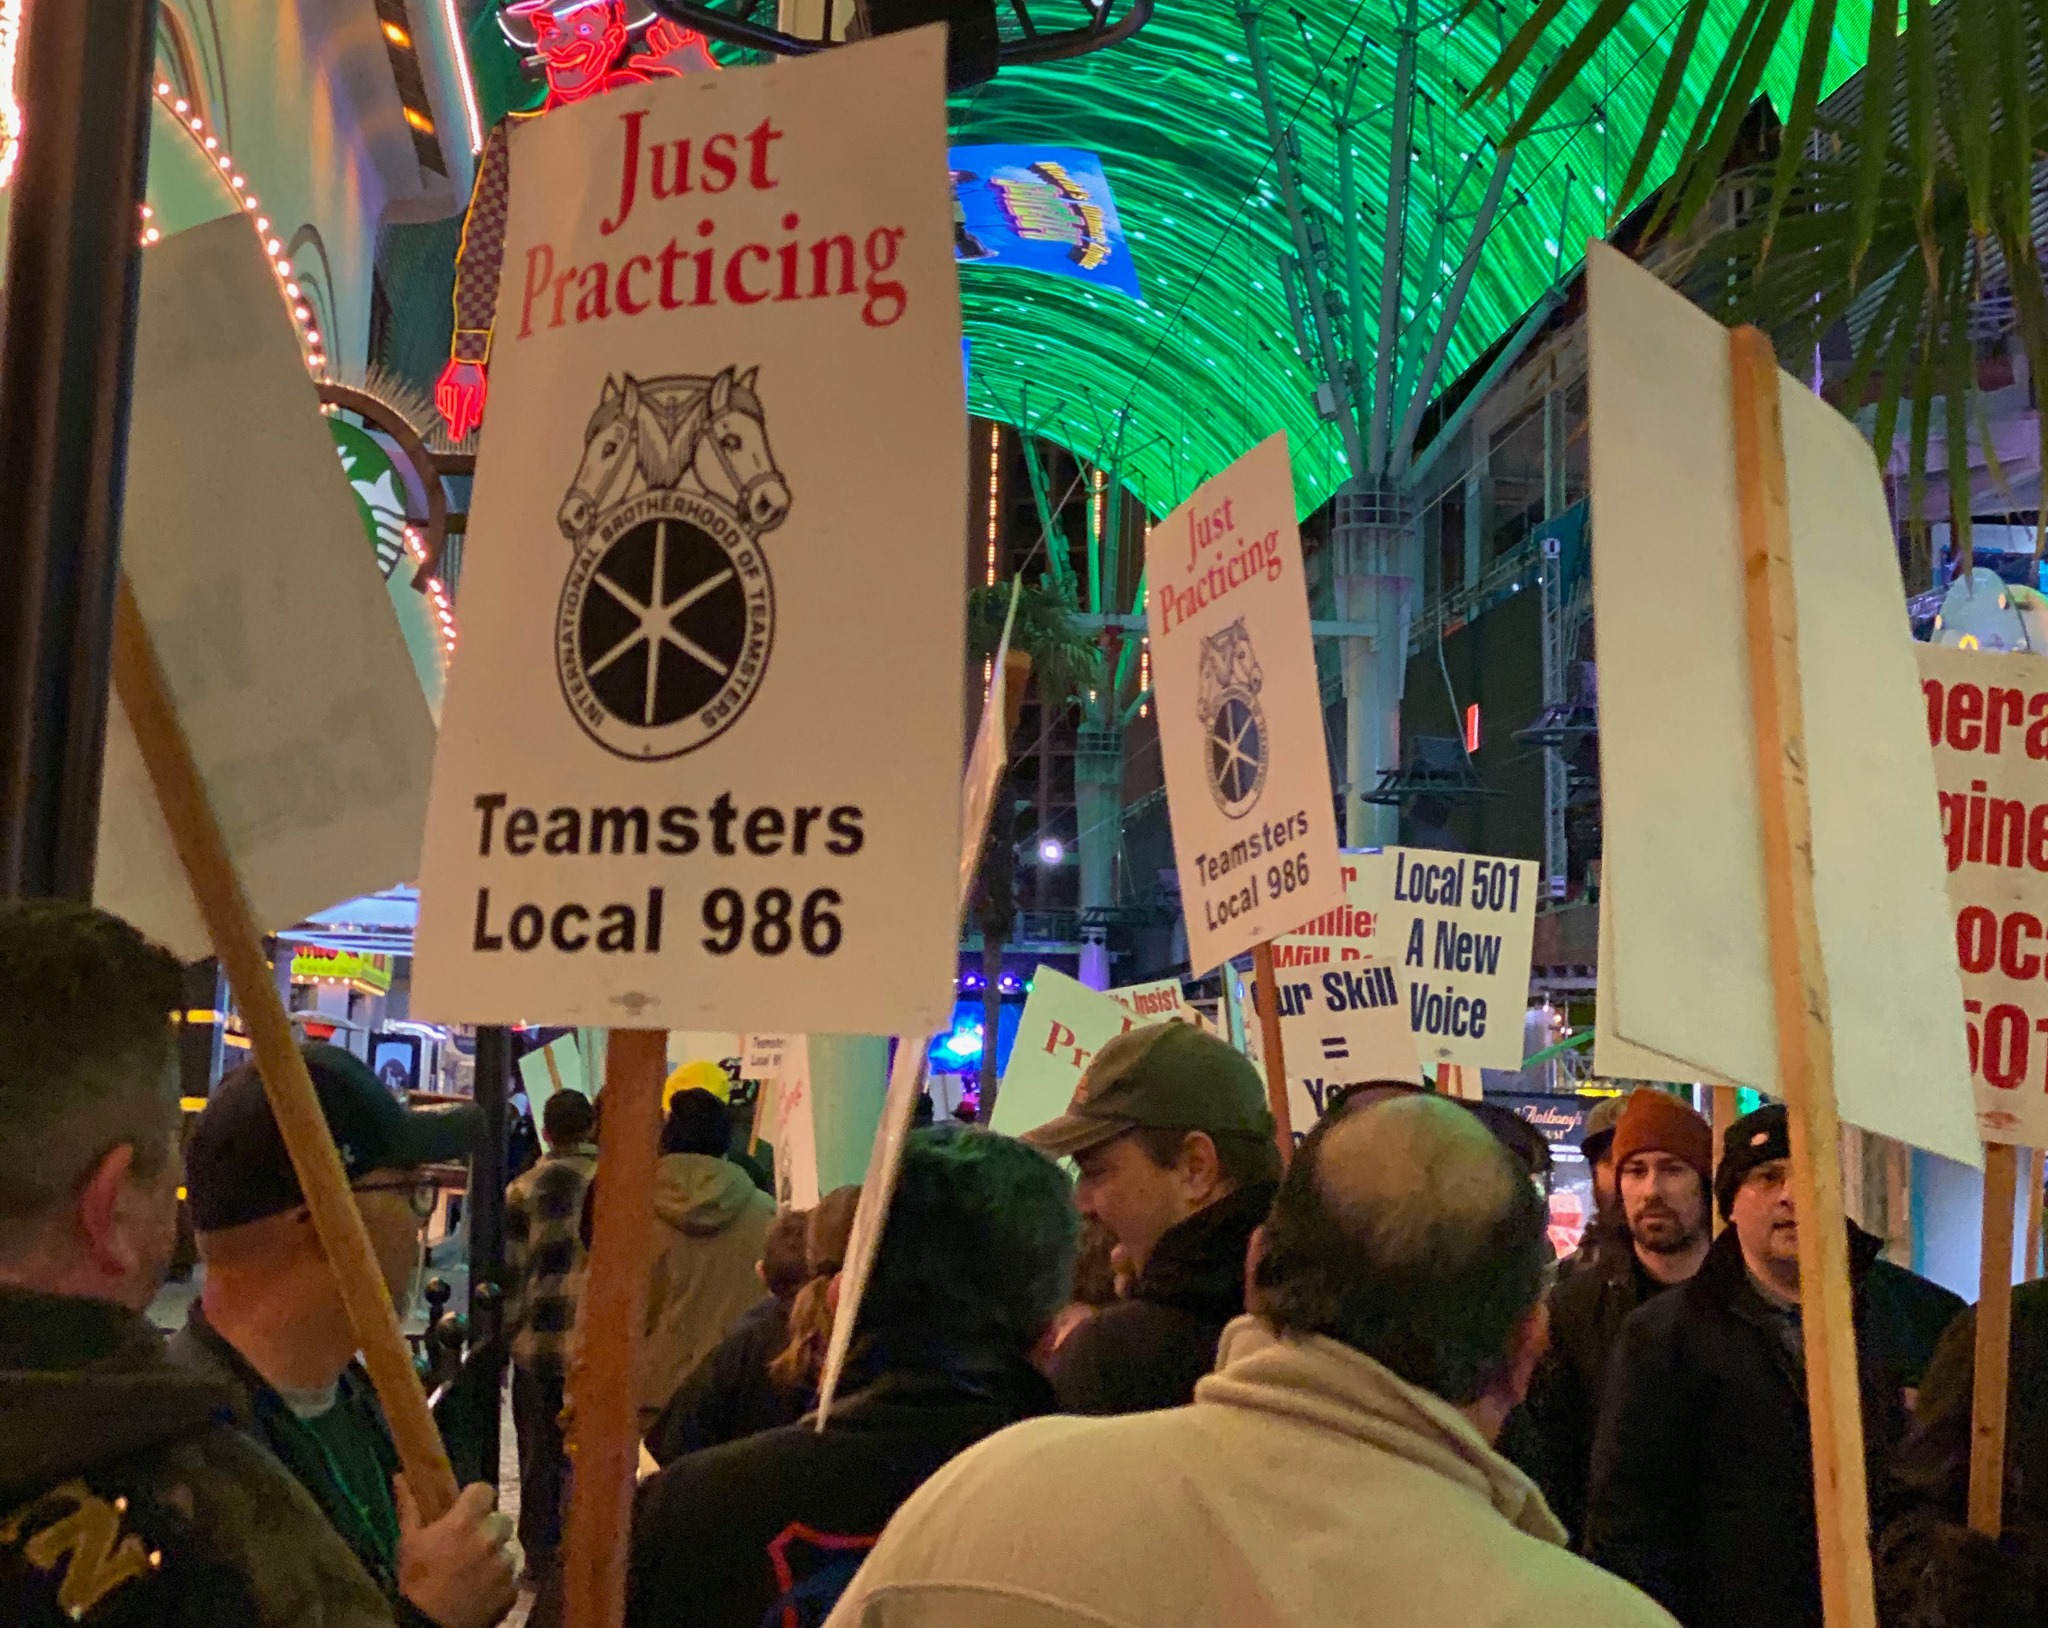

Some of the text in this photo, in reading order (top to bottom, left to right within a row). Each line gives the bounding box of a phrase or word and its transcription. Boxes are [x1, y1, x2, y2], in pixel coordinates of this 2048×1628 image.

[600, 109, 784, 236] Just
[516, 211, 909, 341] Practicing
[1186, 496, 1235, 574] Just
[557, 497, 767, 729] INTERNATIONAL BROTHERHOOD OF TEAMSTERS
[1159, 529, 1283, 637] Practicing
[473, 790, 866, 857] Teamsters
[1195, 810, 1309, 887] Teamsters
[1205, 875, 1260, 932] Local
[1267, 851, 1310, 900] 986
[1394, 851, 1465, 907] Local
[1471, 860, 1520, 913] 501
[472, 886, 844, 957] Local 986
[1405, 917, 1502, 976] A New
[1132, 985, 1181, 1016] Insist
[1322, 965, 1399, 1013] Skill
[1410, 982, 1488, 1039] Voice
